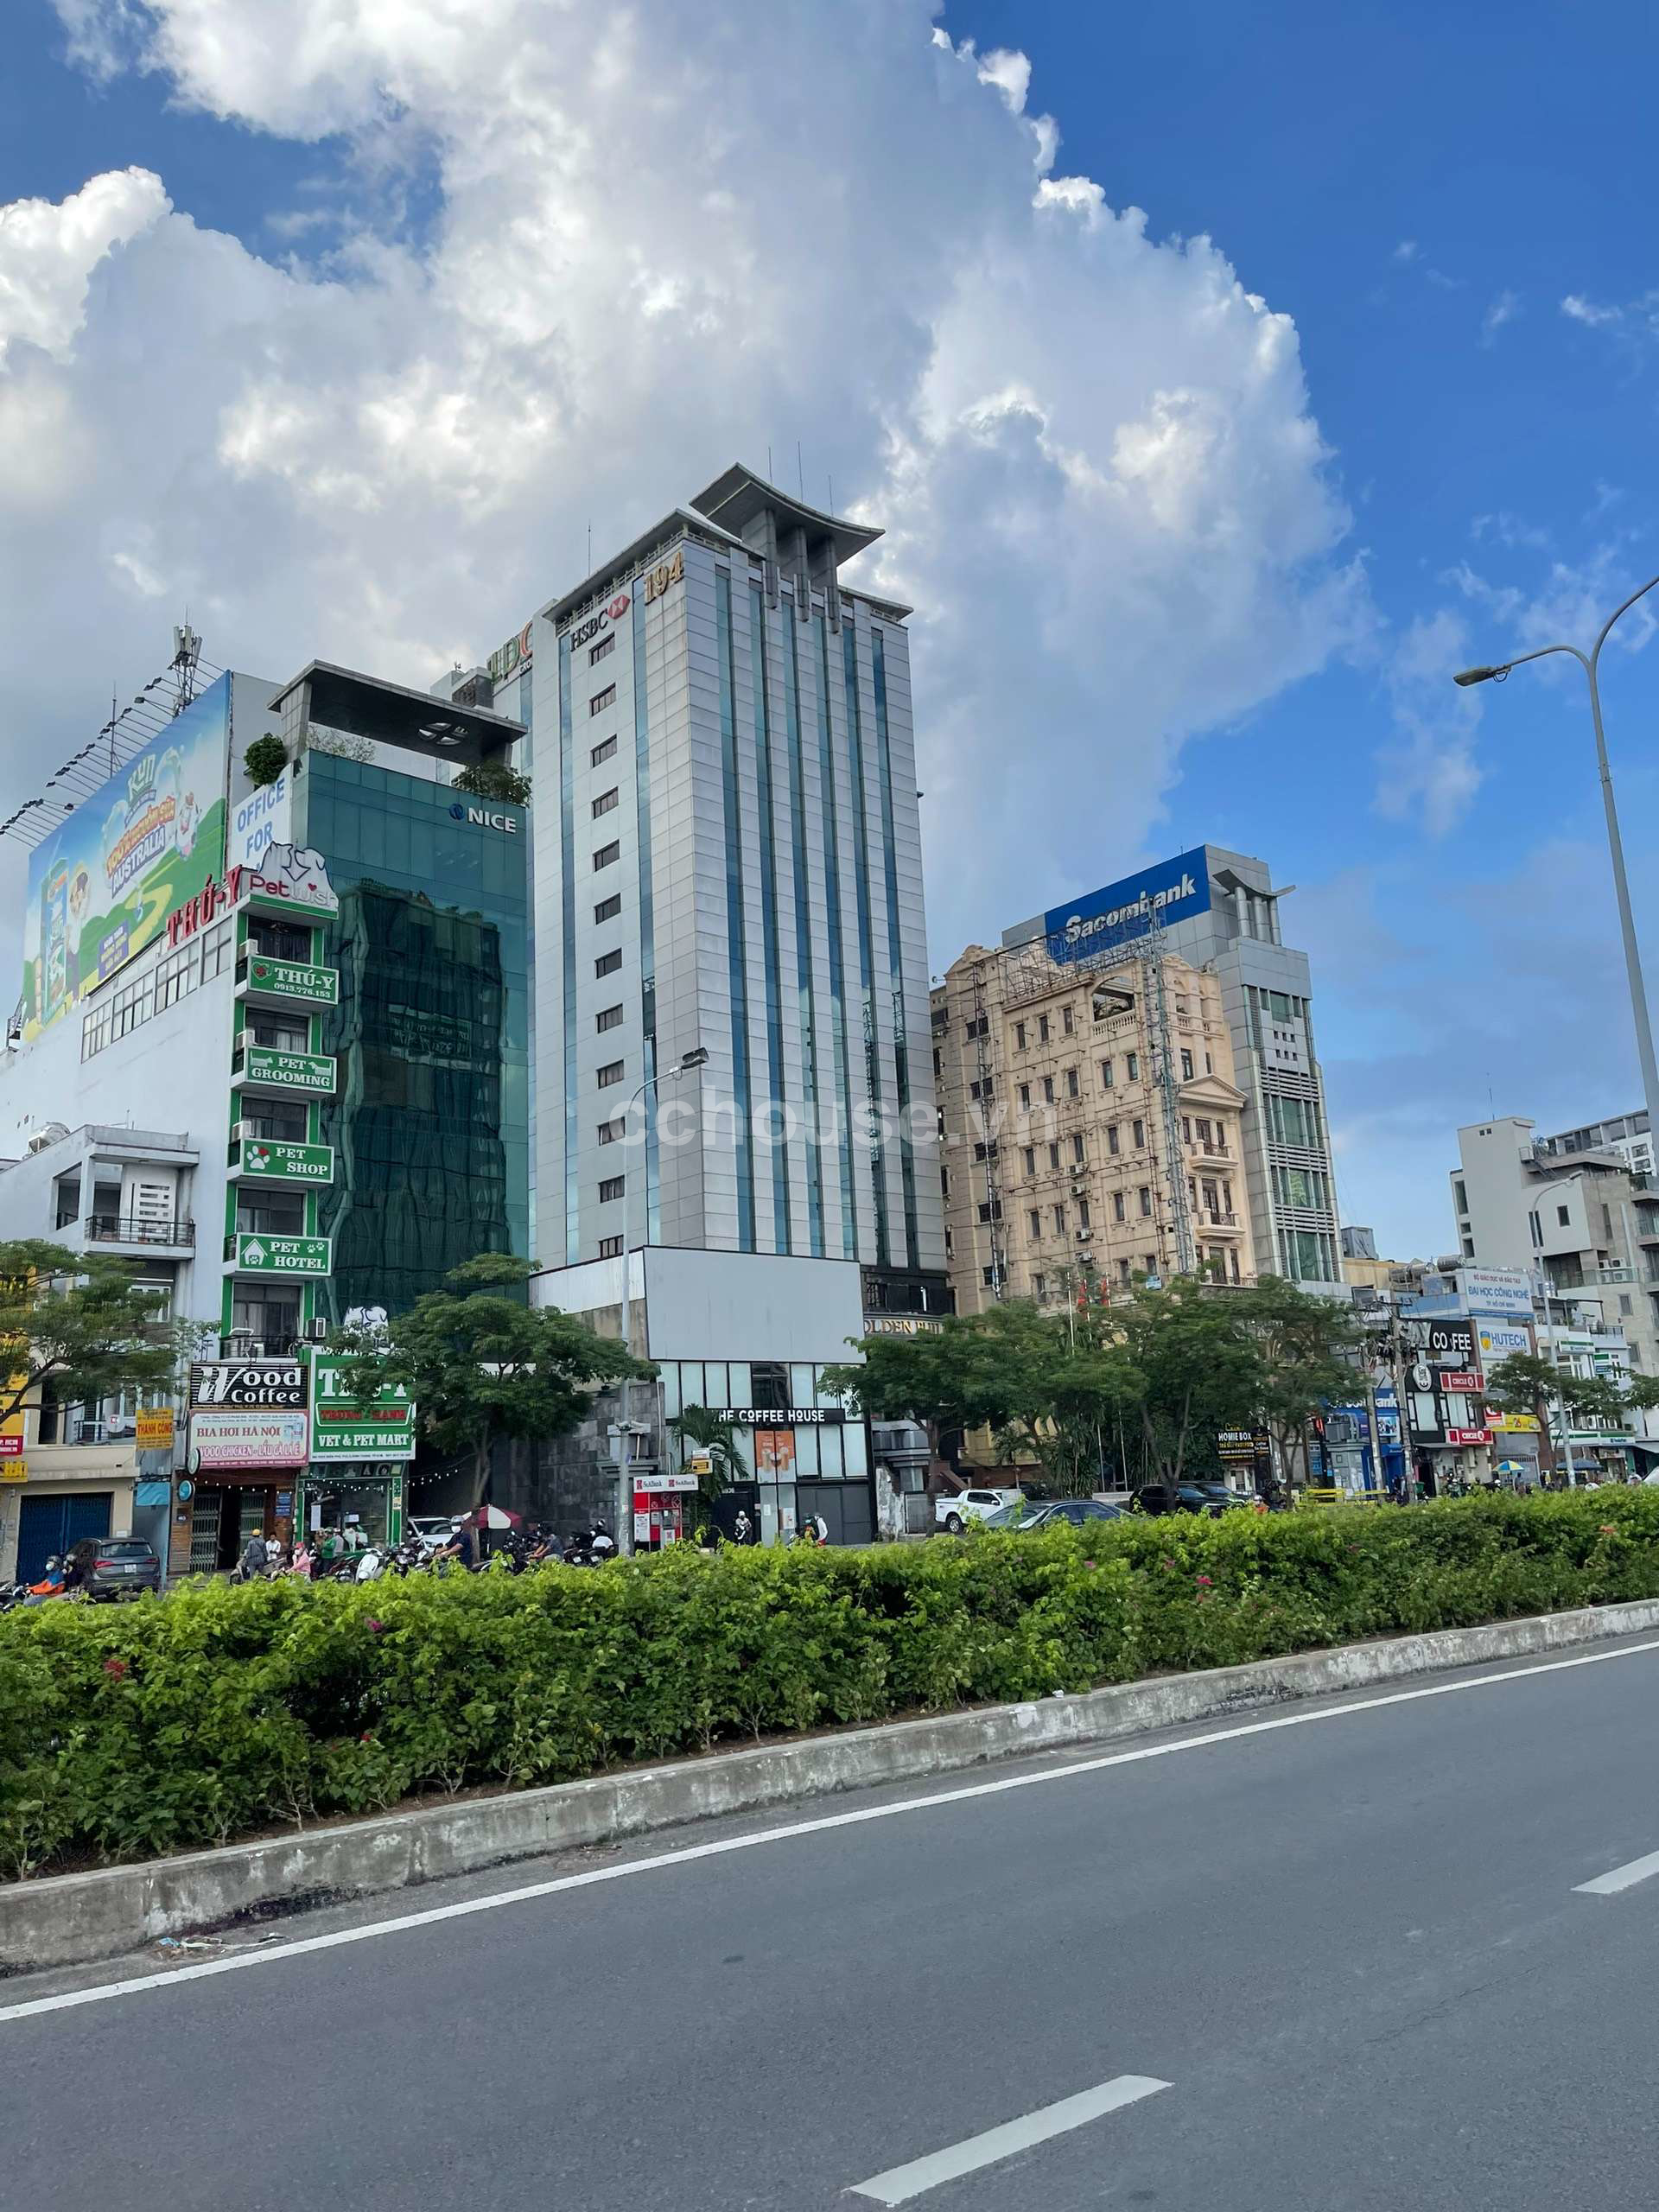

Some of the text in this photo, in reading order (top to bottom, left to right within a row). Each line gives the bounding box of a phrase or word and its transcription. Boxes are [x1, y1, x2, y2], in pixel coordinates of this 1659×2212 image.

[644, 552, 684, 605] 194
[570, 608, 609, 652] HSBC
[237, 778, 286, 832] OFFICE
[468, 807, 517, 833] NICE
[245, 821, 274, 859] FOR
[111, 824, 166, 898] AUSTRALIA
[1065, 874, 1197, 944] Sacombank
[275, 968, 335, 990] THÚ-Y
[278, 1057, 306, 1071] PET
[251, 1067, 330, 1087] GROOMING
[276, 1147, 306, 1160] PET
[286, 1162, 328, 1176] SHOP
[270, 1242, 301, 1253] PET
[274, 1255, 326, 1269] HOTEL
[1433, 1332, 1471, 1351] COFEE
[1491, 1332, 1526, 1346] HUTECH
[198, 1367, 302, 1402] Wood
[231, 1389, 301, 1402] Coffee
[714, 1409, 825, 1422] HE COFFEE HOUSE
[197, 1427, 217, 1438] BIA
[318, 1433, 409, 1446] VET & PET MART
[221, 1445, 252, 1457] CHICKEN
